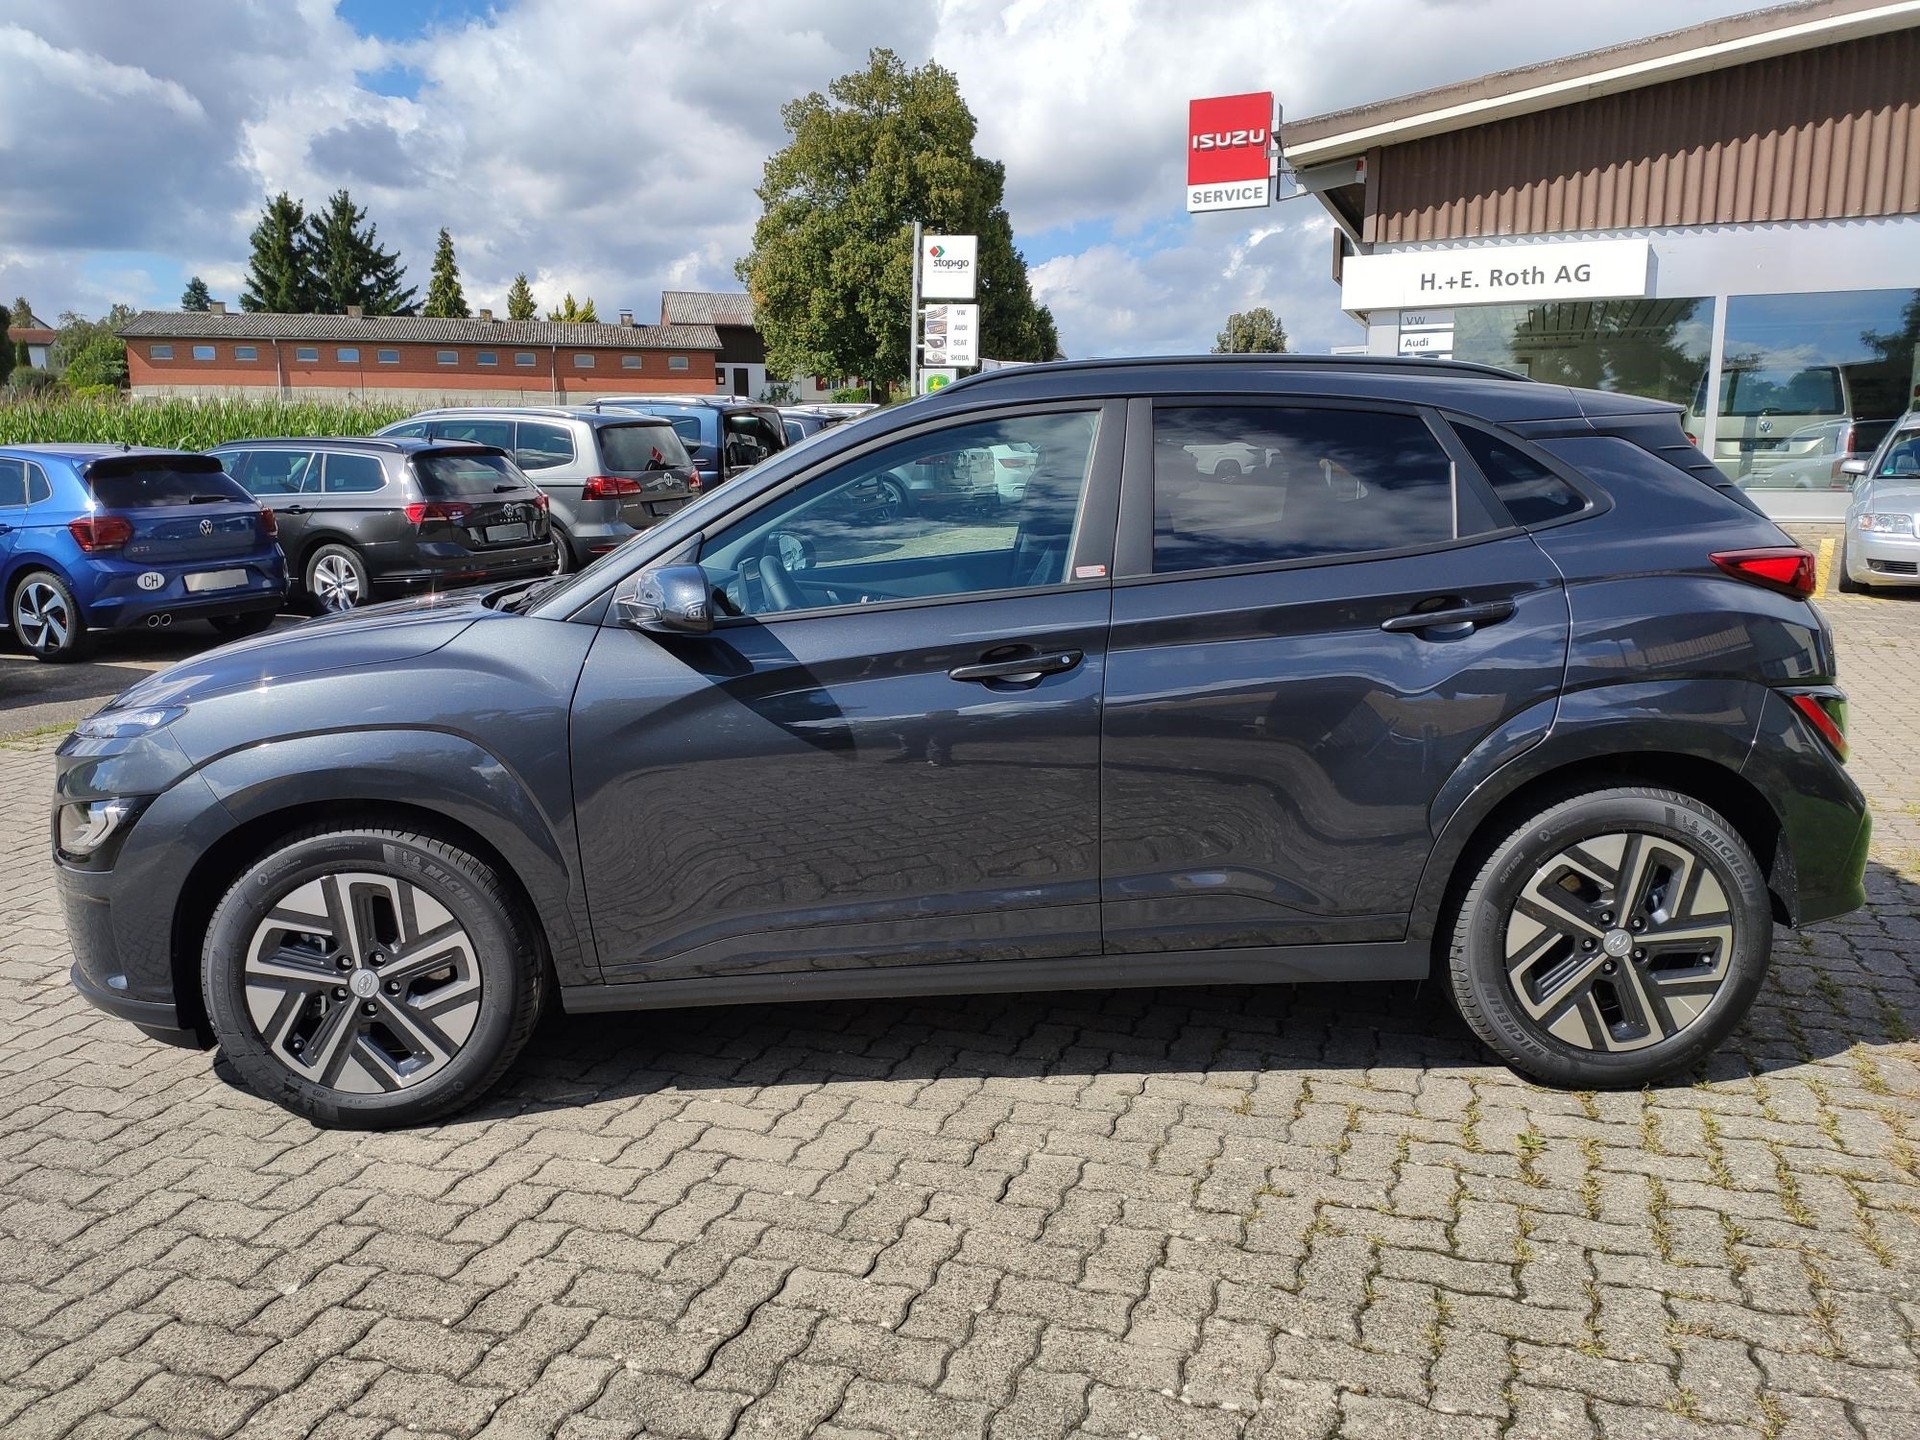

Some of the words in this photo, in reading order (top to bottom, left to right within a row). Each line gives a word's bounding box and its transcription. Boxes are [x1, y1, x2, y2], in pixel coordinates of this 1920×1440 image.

[1192, 128, 1266, 152] ISUZU
[1192, 187, 1263, 204] SERVICE
[933, 259, 969, 269] stop+go
[1420, 270, 1480, 291] H.+E.
[1489, 265, 1545, 287] Roth
[1554, 263, 1591, 284] AG
[1406, 316, 1426, 325] VW
[1405, 338, 1429, 347] Audi
[144, 575, 159, 588] CH
[1700, 828, 1760, 904] MICHELIN
[1482, 984, 1546, 1059] MICHELIN
